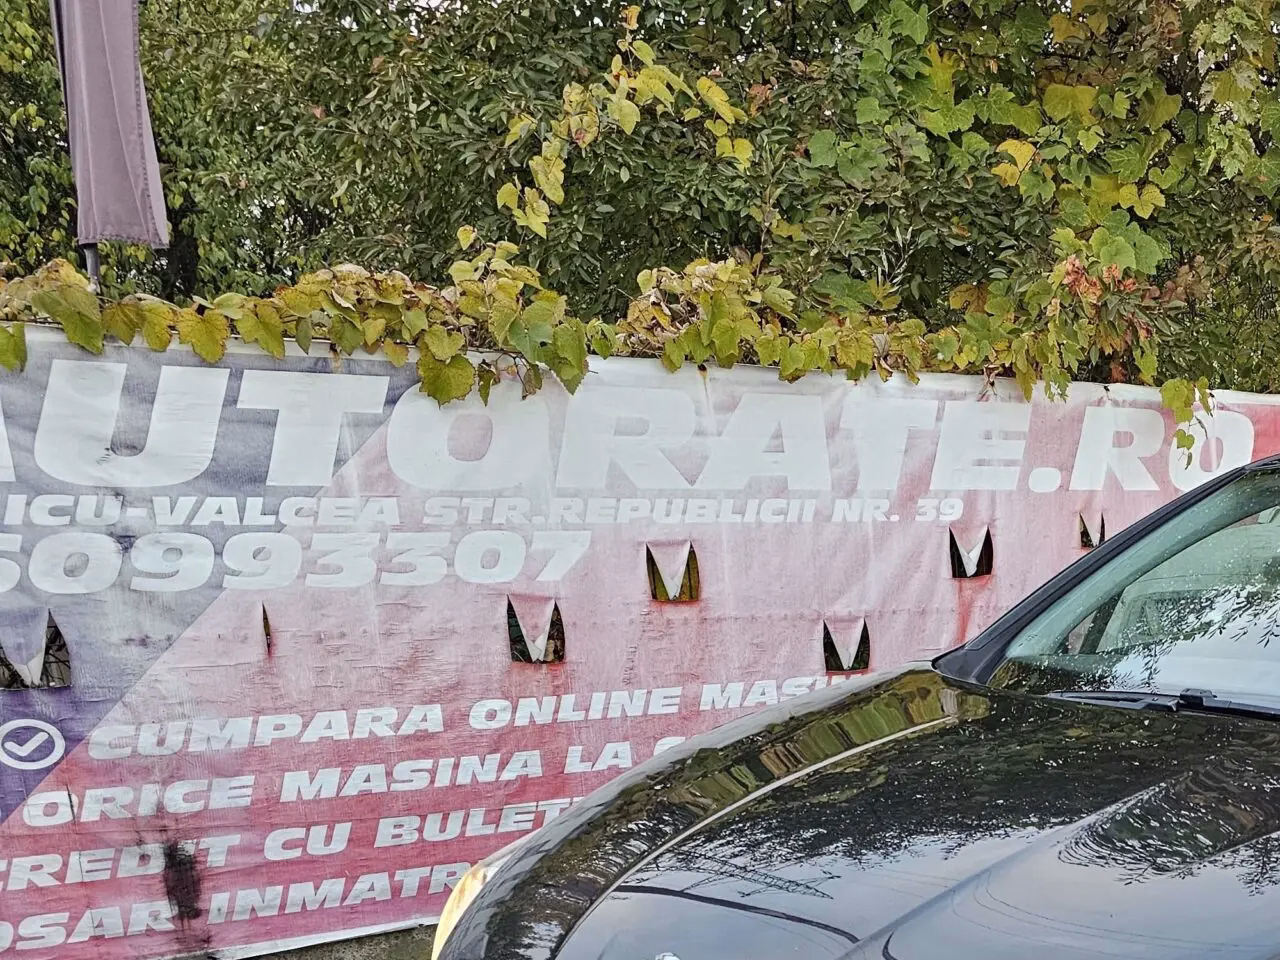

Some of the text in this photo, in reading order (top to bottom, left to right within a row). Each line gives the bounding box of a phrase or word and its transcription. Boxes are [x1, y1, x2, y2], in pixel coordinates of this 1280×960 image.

[0, 359, 1255, 493] UTORATE.RO
[831, 498, 900, 522] NR.
[914, 498, 964, 521] 39
[0, 531, 592, 594] 0993307
[88, 703, 444, 760] CUMPARA
[468, 686, 683, 730] ONLINE
[23, 776, 255, 827] ORICE
[280, 754, 543, 803] MASINA
[564, 741, 633, 774] LA
[264, 822, 352, 861] CU
[374, 797, 585, 849] BULET
[0, 900, 180, 951] SAR
